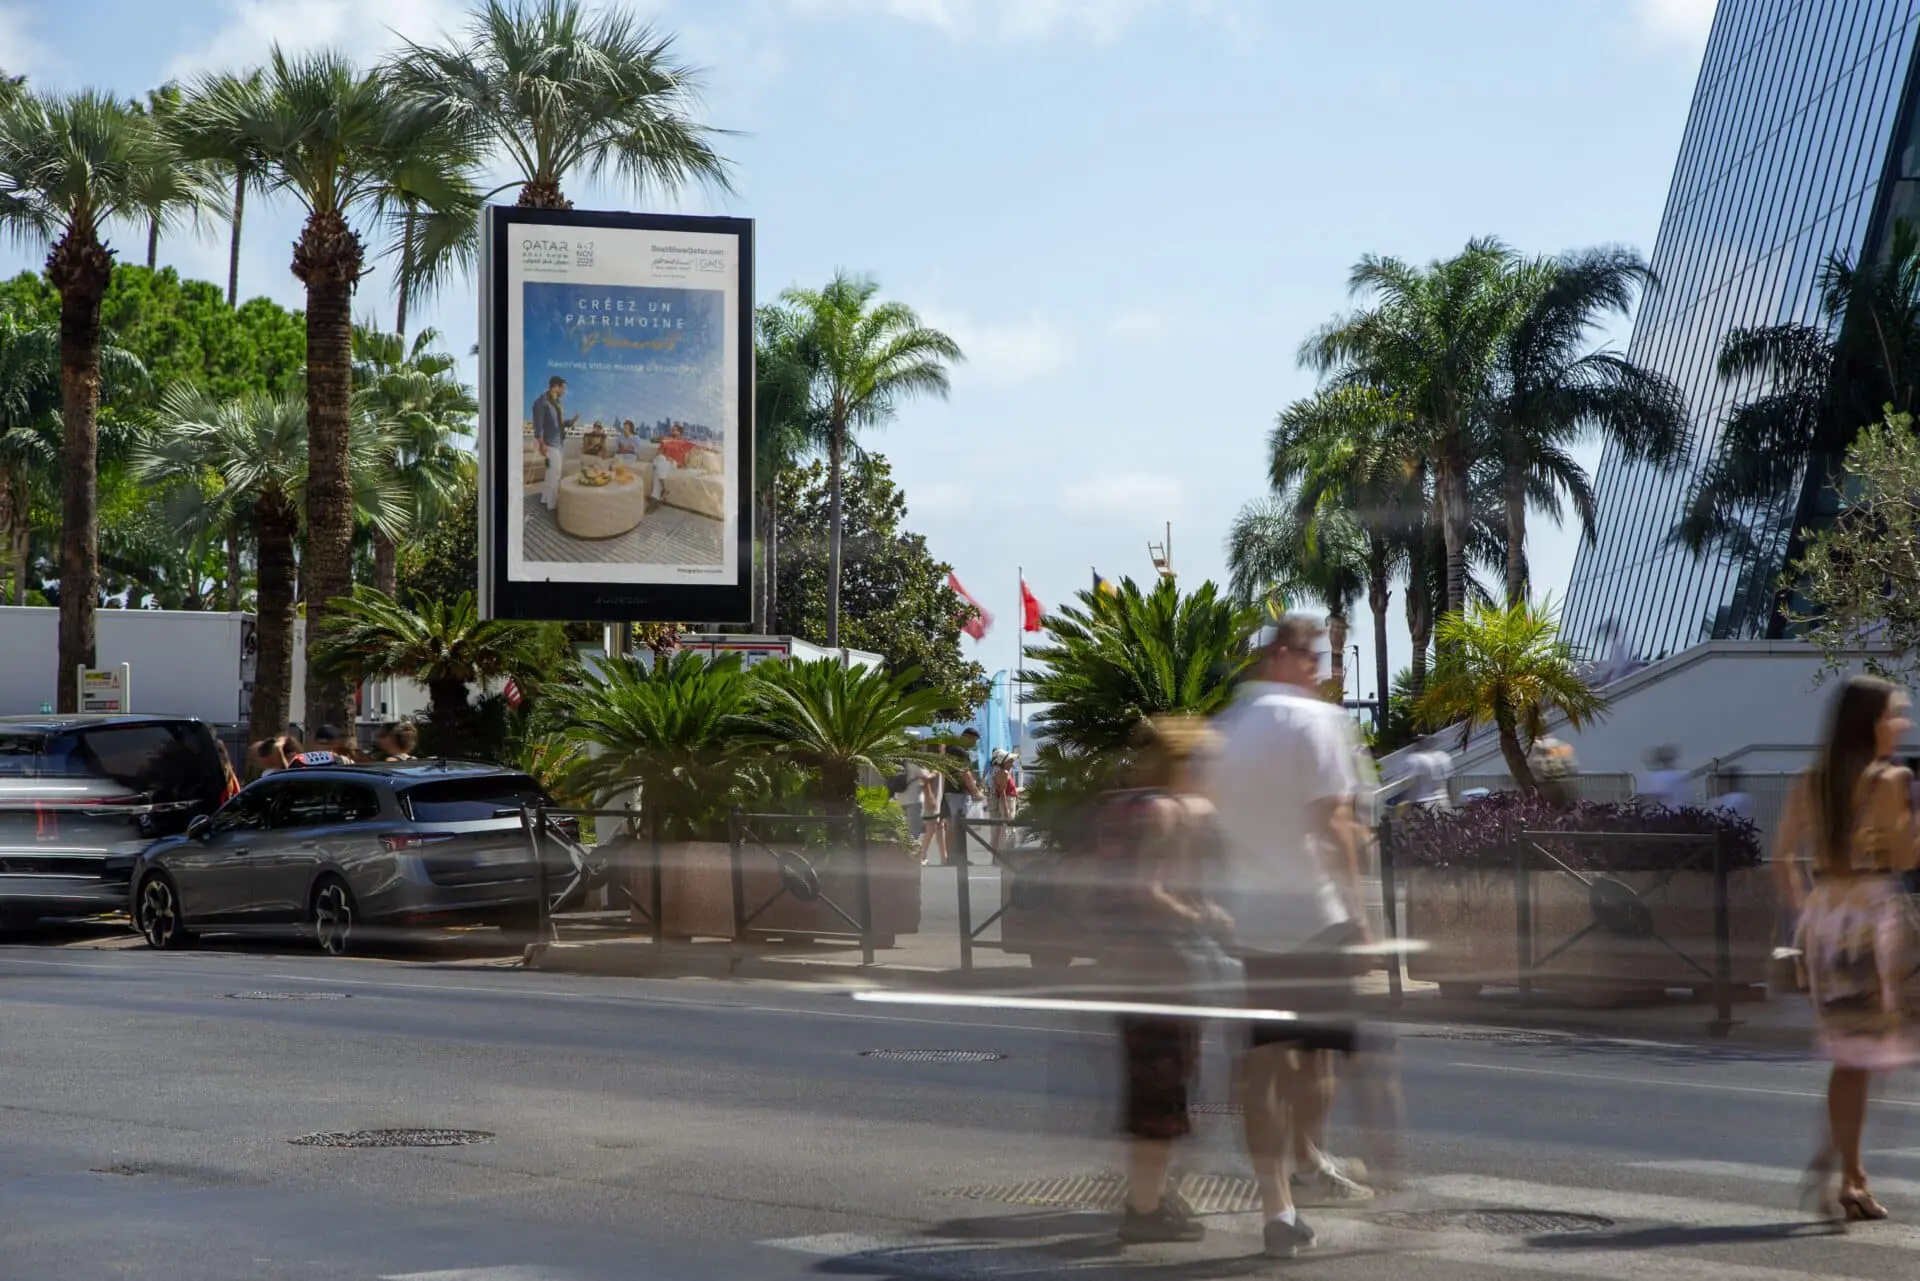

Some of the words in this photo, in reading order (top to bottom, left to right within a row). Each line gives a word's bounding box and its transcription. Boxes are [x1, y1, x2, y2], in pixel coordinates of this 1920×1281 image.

[522, 239, 568, 251] QATAR
[578, 297, 637, 312] CRÉEZ
[649, 302, 671, 313] UN
[565, 315, 685, 329] PATRIMOINE
